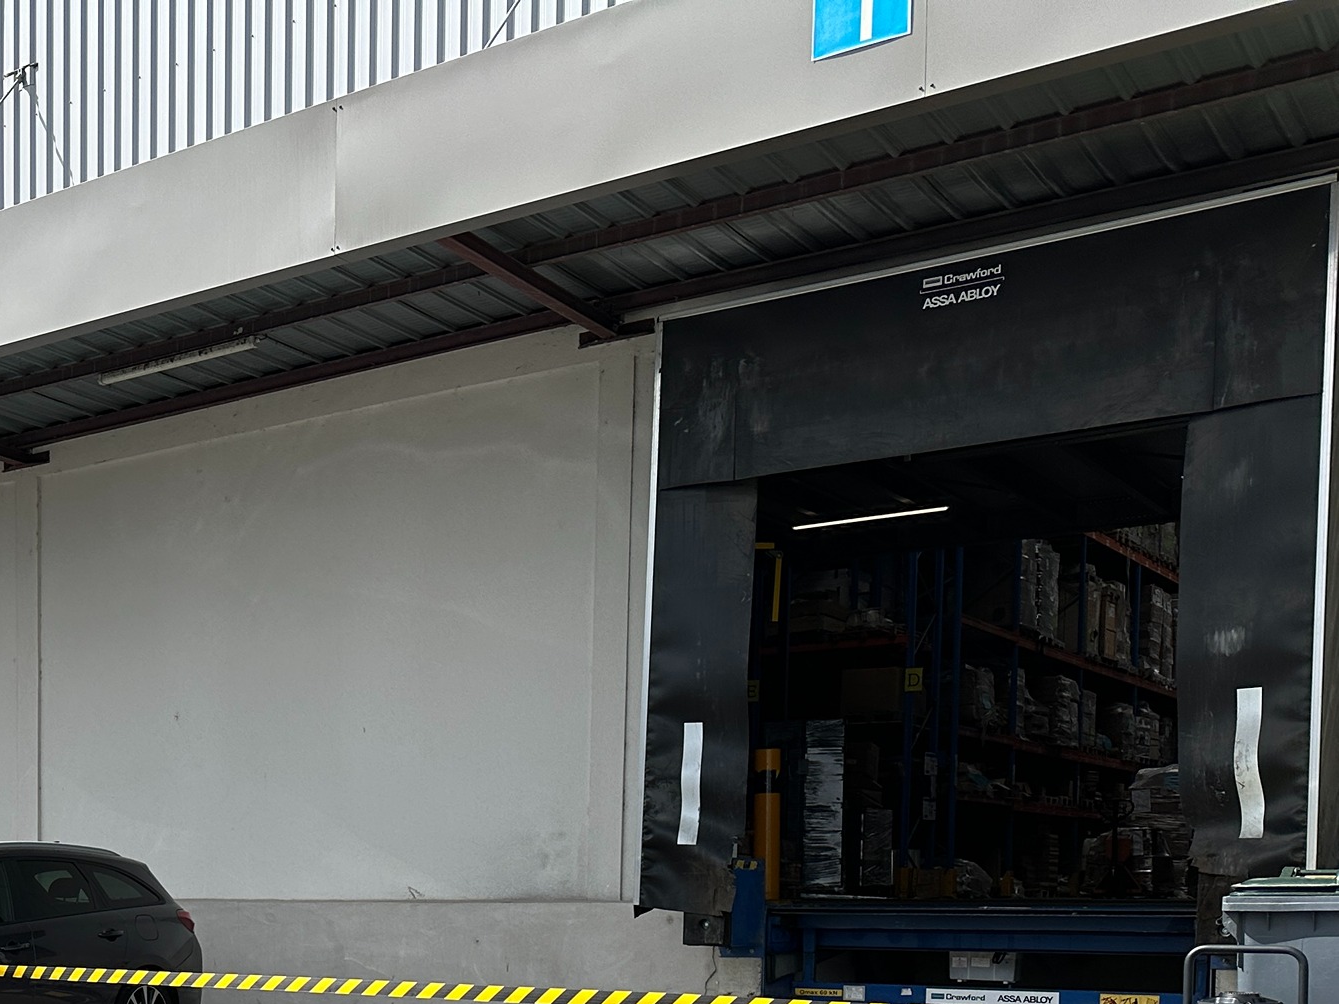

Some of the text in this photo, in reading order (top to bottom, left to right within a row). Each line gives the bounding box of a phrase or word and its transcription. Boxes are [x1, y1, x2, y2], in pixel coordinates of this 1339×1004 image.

[944, 264, 1002, 285] Crawford
[922, 284, 1001, 310] ASSA ABLOY
[907, 673, 920, 687] D
[748, 685, 757, 698] E
[945, 993, 1054, 1004] Crawford ASSA ABLOY
